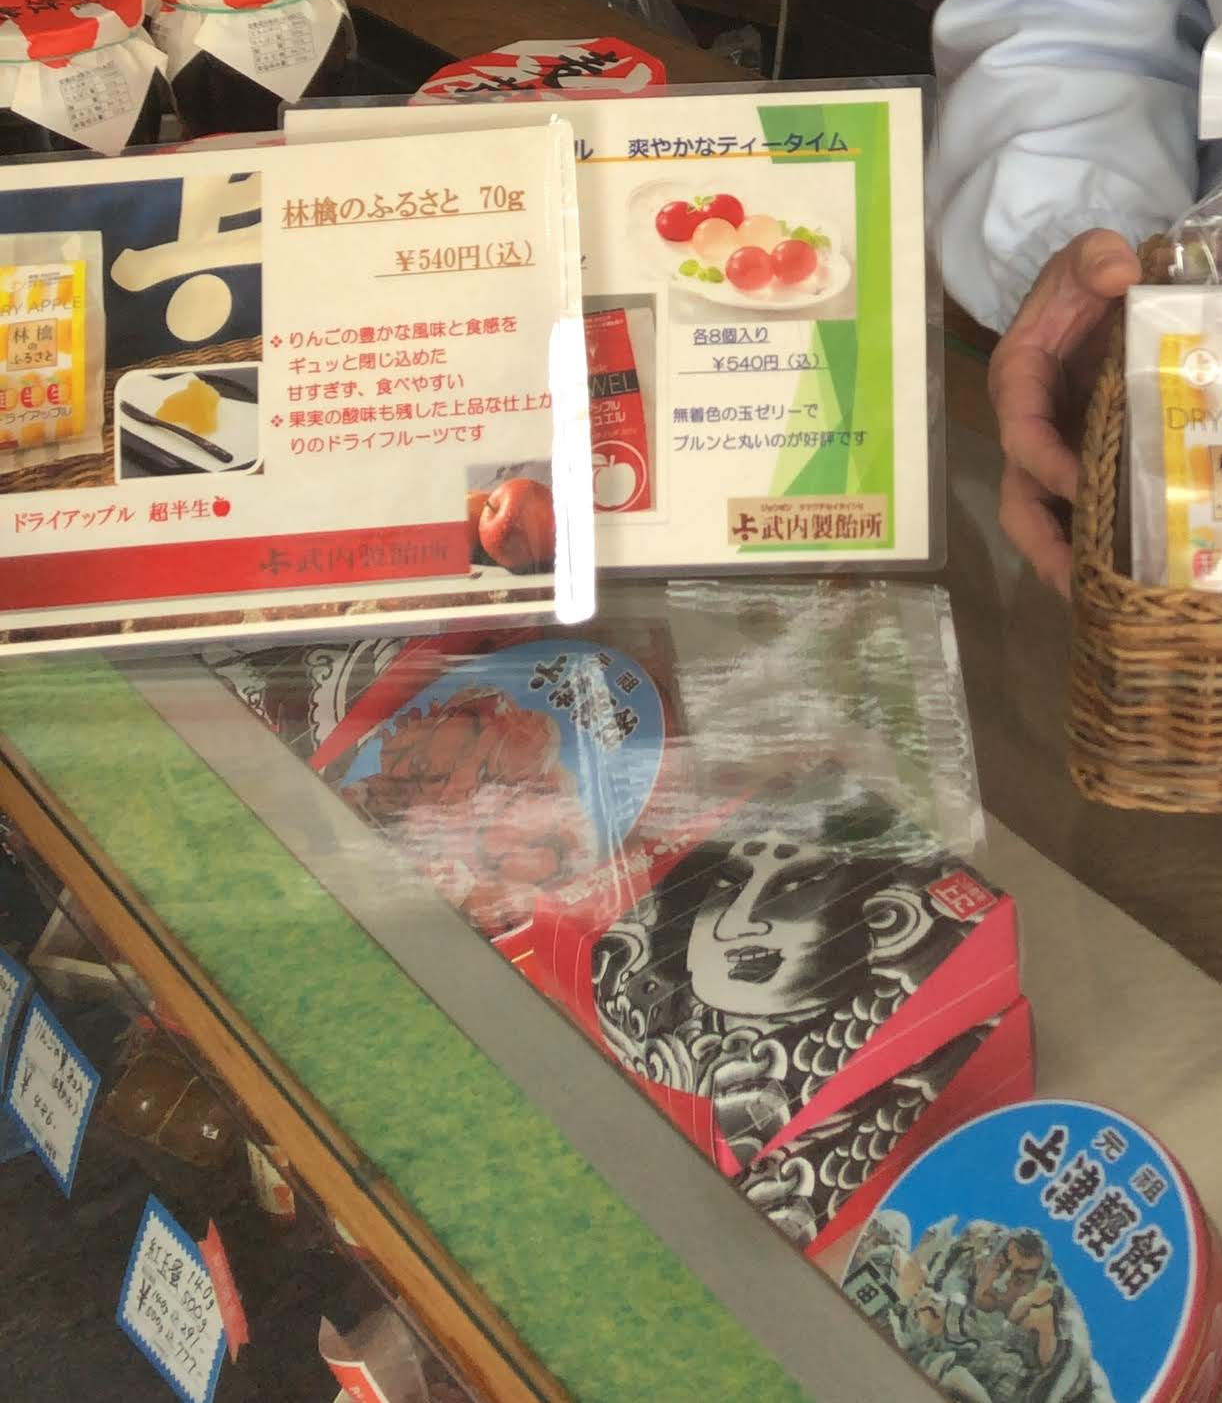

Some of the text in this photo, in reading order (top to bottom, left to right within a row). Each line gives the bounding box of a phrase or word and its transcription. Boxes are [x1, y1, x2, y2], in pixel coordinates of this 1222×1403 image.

[628, 131, 849, 160] 爽やかなティータイム
[281, 184, 526, 227] 林檎のふるさと 70g
[288, 315, 518, 349] りんごの豊かな風味と食感を
[692, 326, 769, 345] 各8個入り
[288, 347, 448, 375] ギュッと閉じ込めた
[287, 372, 465, 402] 甘すぎず、食べやすい
[1165, 406, 1222, 432] DRY
[289, 424, 486, 455] りのドライフルーツです
[14, 498, 211, 534] ドライアップル 超半生
[761, 509, 883, 541] 武内製飴所
